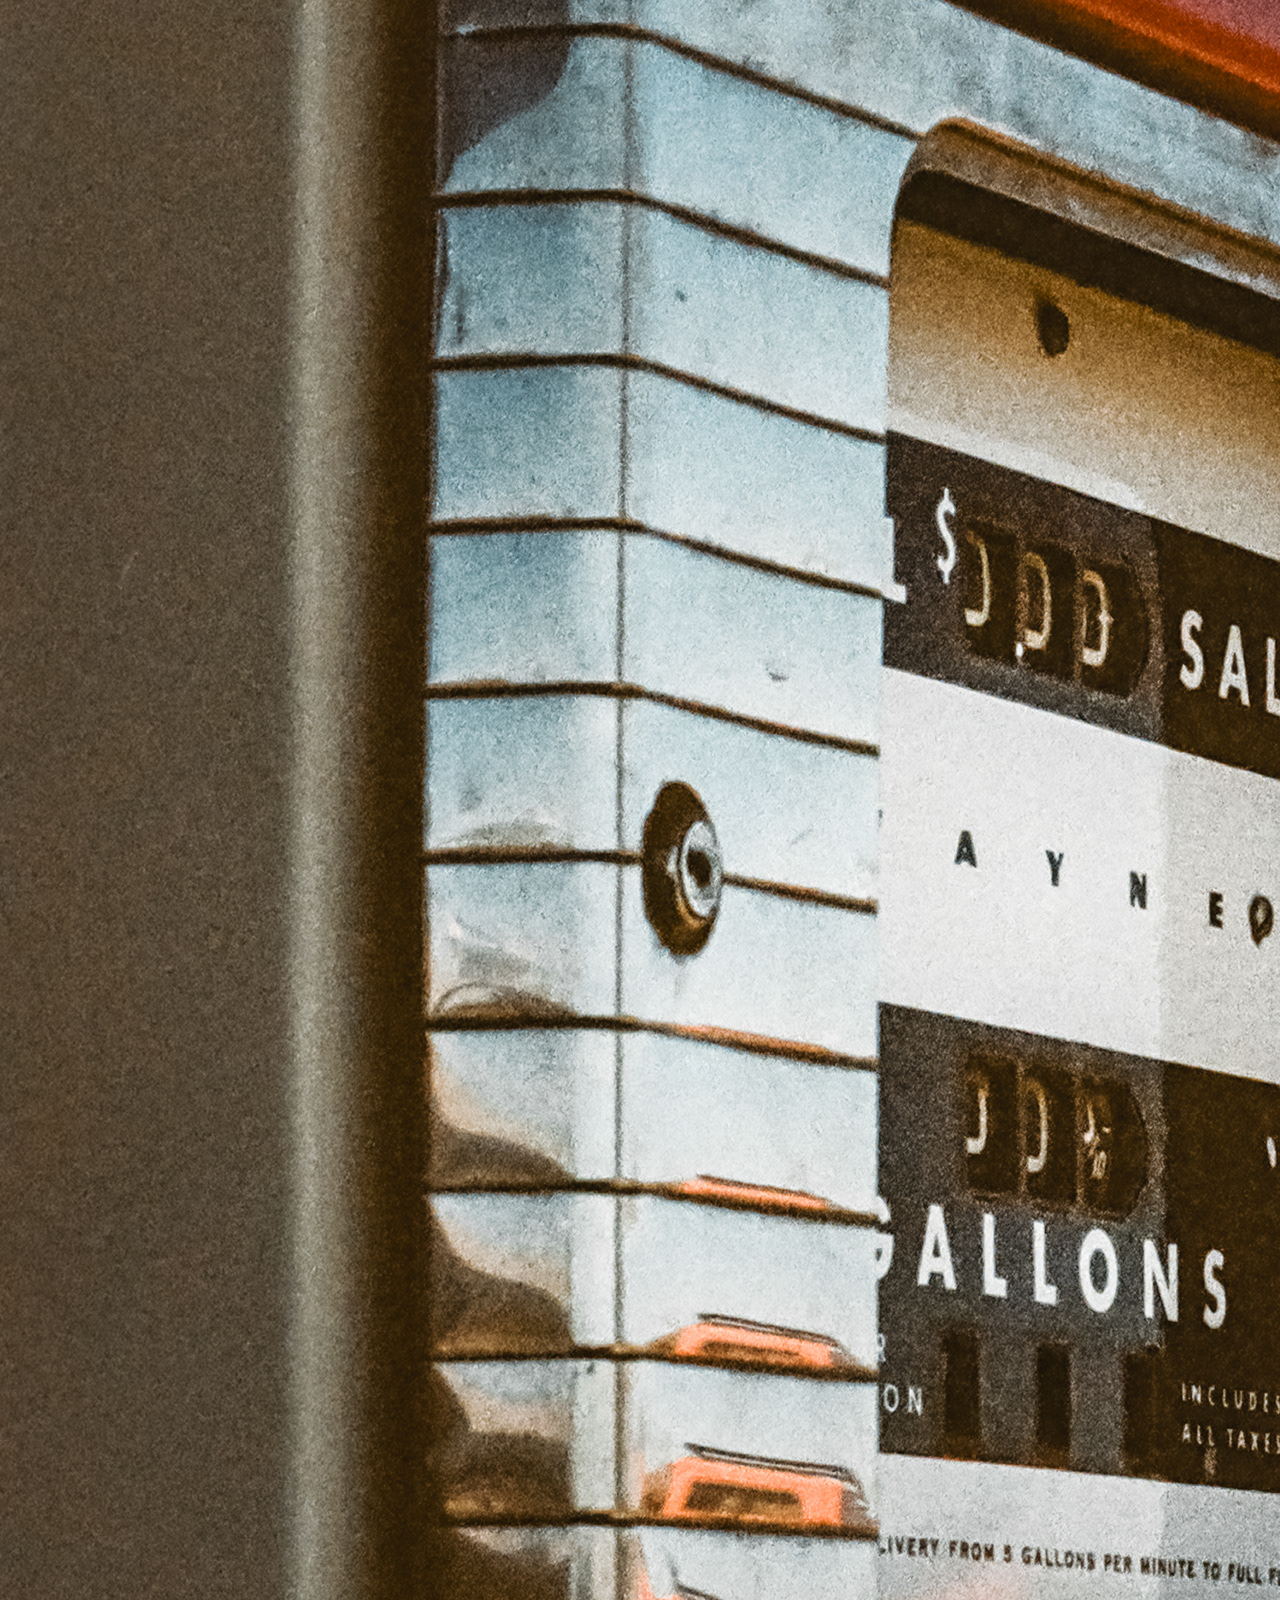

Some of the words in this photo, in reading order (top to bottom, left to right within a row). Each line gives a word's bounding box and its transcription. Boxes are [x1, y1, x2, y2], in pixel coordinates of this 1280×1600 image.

[1181, 1422, 1216, 1447] ALL
[949, 1539, 995, 1563] FROM
[1003, 1544, 1013, 1565] 5
[1021, 1546, 1096, 1571] GALLONS
[1103, 1552, 1133, 1574] PER
[1140, 1556, 1196, 1580] MINUTE
[1203, 1561, 1221, 1581] TO
[1228, 1563, 1263, 1586] FULL
